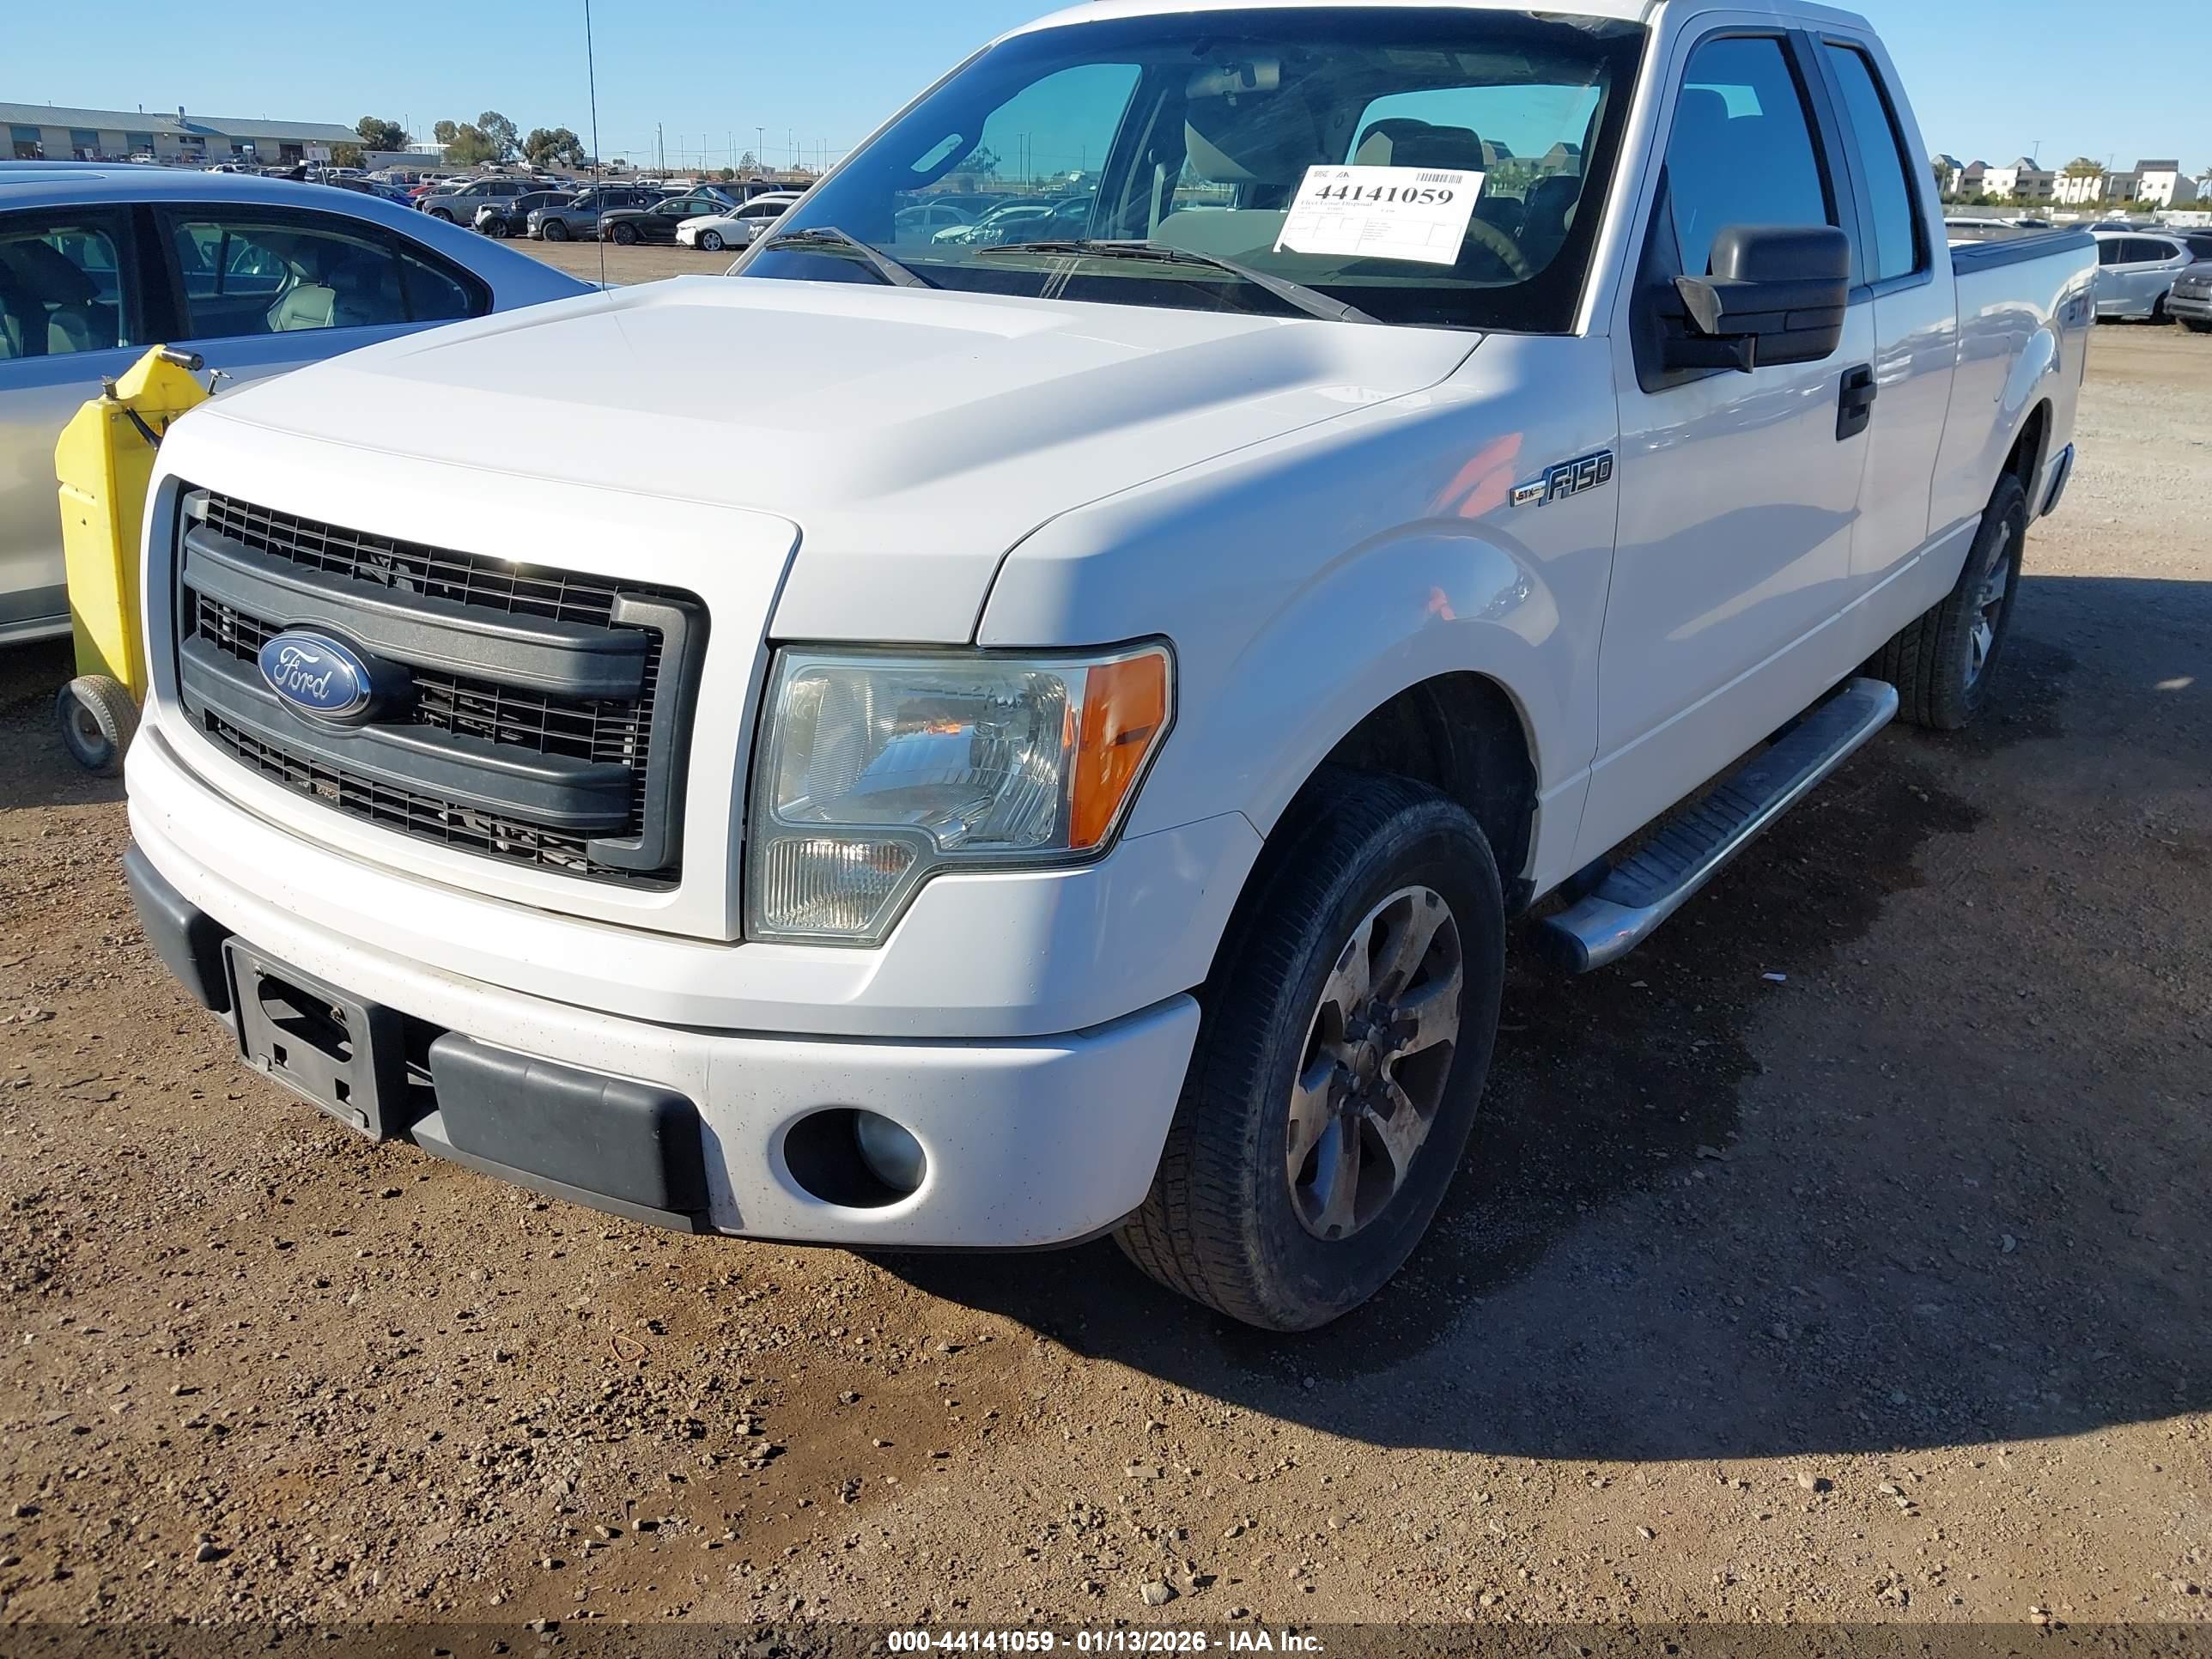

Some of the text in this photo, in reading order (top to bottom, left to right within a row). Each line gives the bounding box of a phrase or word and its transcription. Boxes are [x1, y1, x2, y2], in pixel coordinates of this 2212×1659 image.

[1315, 185, 1455, 206] 44141059
[1546, 451, 1614, 503] F-150
[274, 646, 333, 701] Ford
